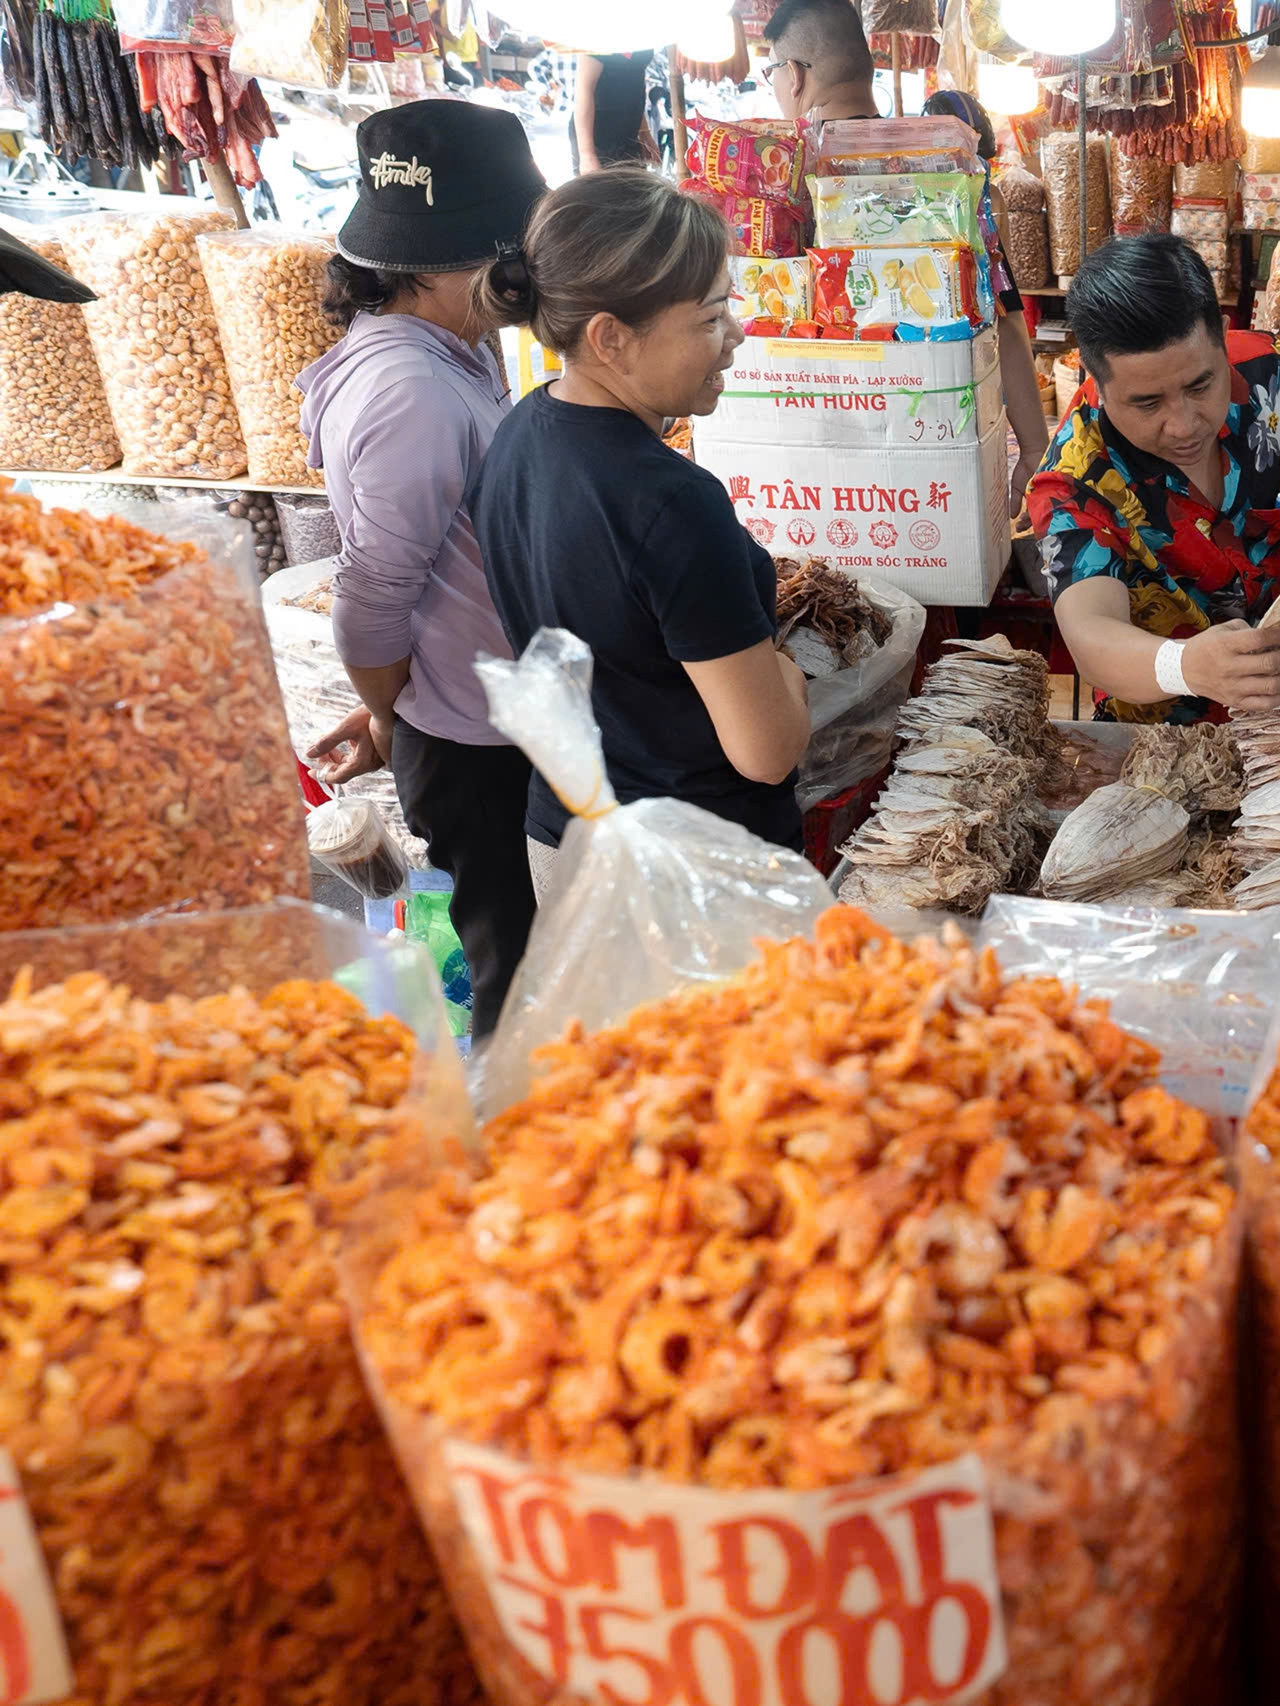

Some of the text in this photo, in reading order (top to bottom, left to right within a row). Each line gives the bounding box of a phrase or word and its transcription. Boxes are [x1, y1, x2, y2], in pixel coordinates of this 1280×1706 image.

[760, 478, 920, 513] TÂN HƯNG
[876, 554, 901, 567] SÓC
